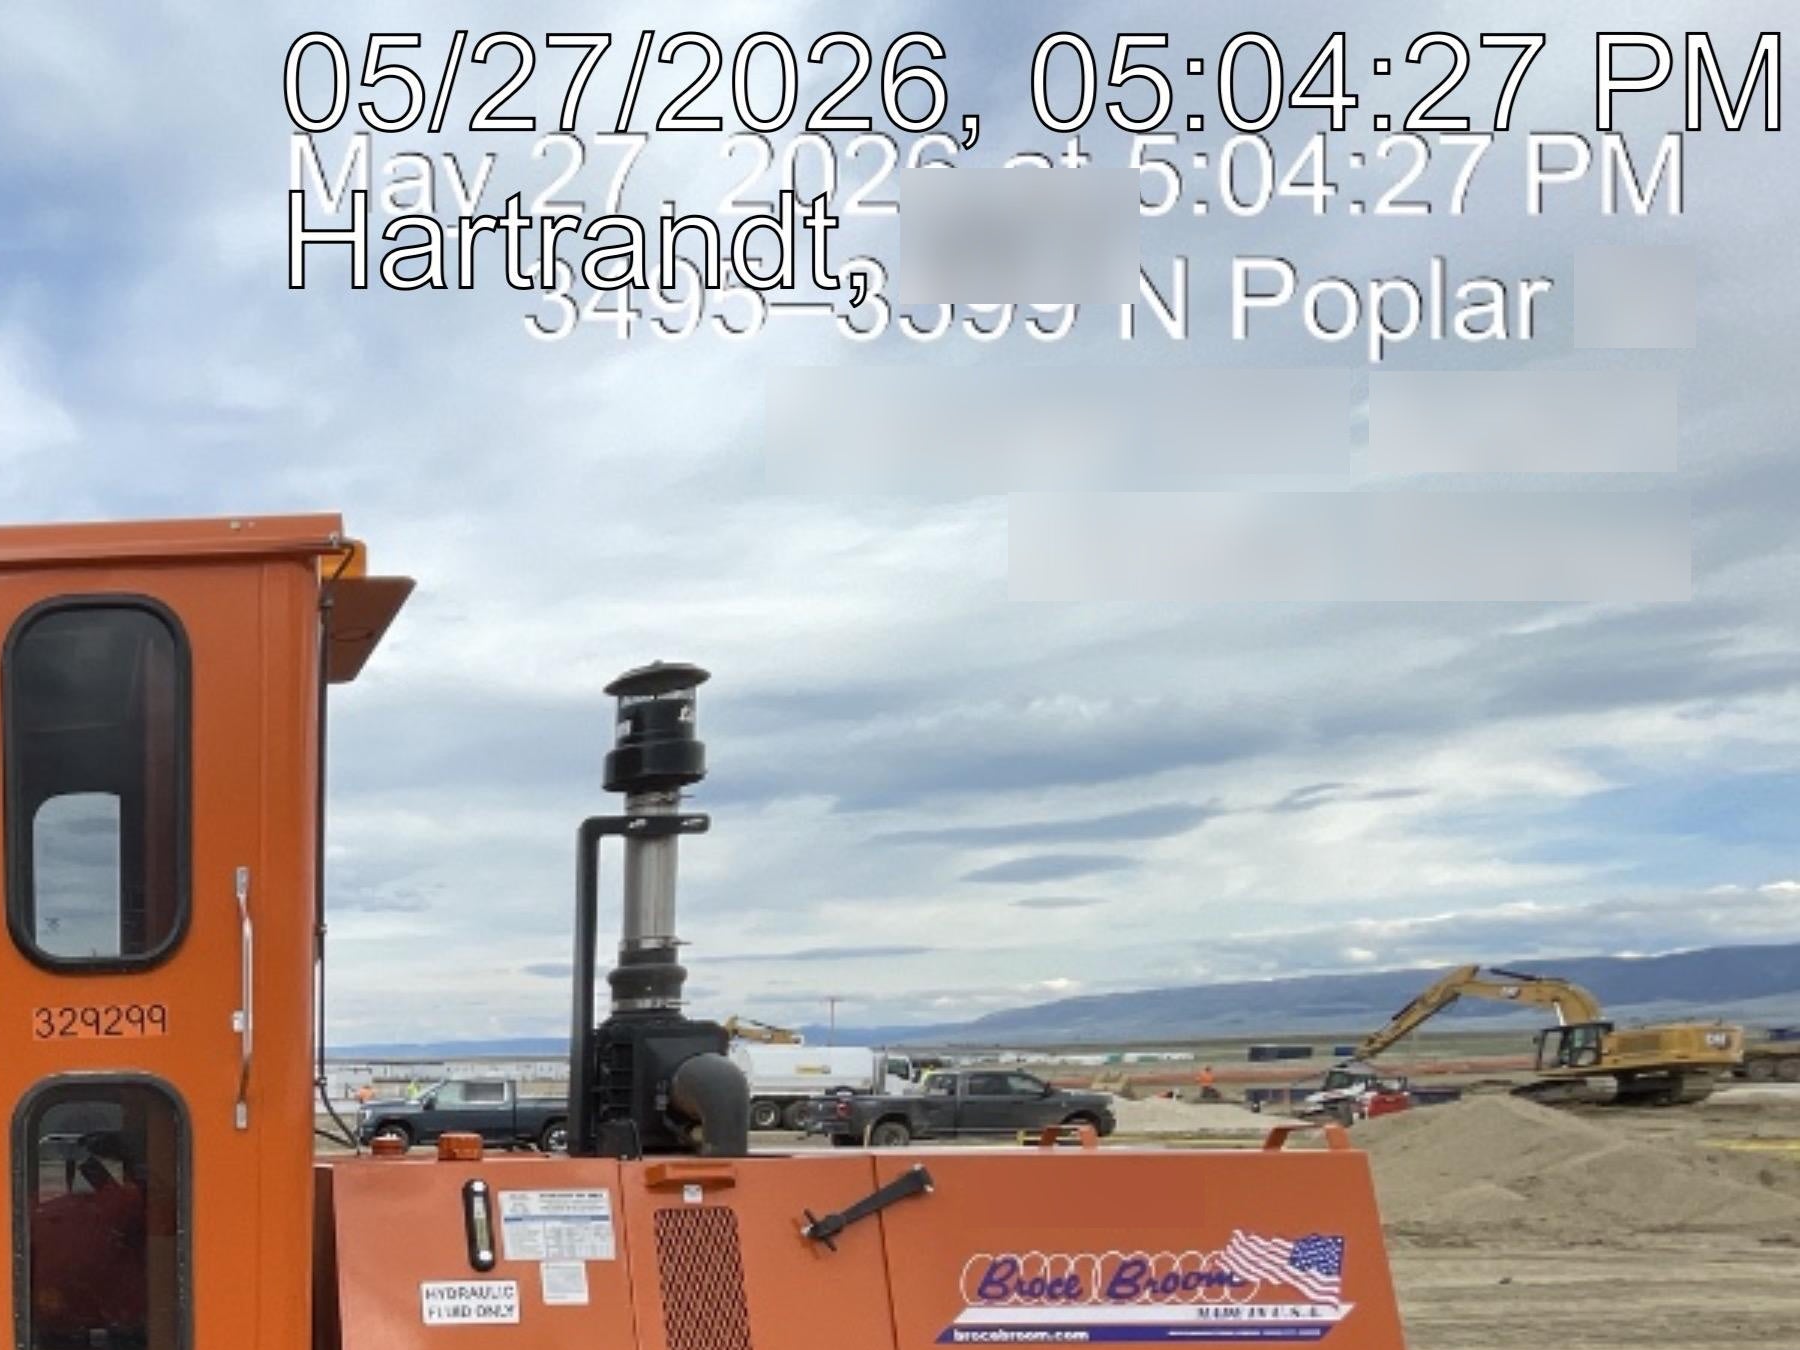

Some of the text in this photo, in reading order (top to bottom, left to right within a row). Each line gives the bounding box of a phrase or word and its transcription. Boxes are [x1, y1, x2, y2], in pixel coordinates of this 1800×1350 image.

[35, 1004, 167, 1038] 329299
[977, 1257, 1248, 1300] Broce Broom
[425, 1285, 515, 1300] HYDRAULIC
[427, 1303, 515, 1319] FLUID ONLY
[952, 1328, 1090, 1342] brocebroom.com
